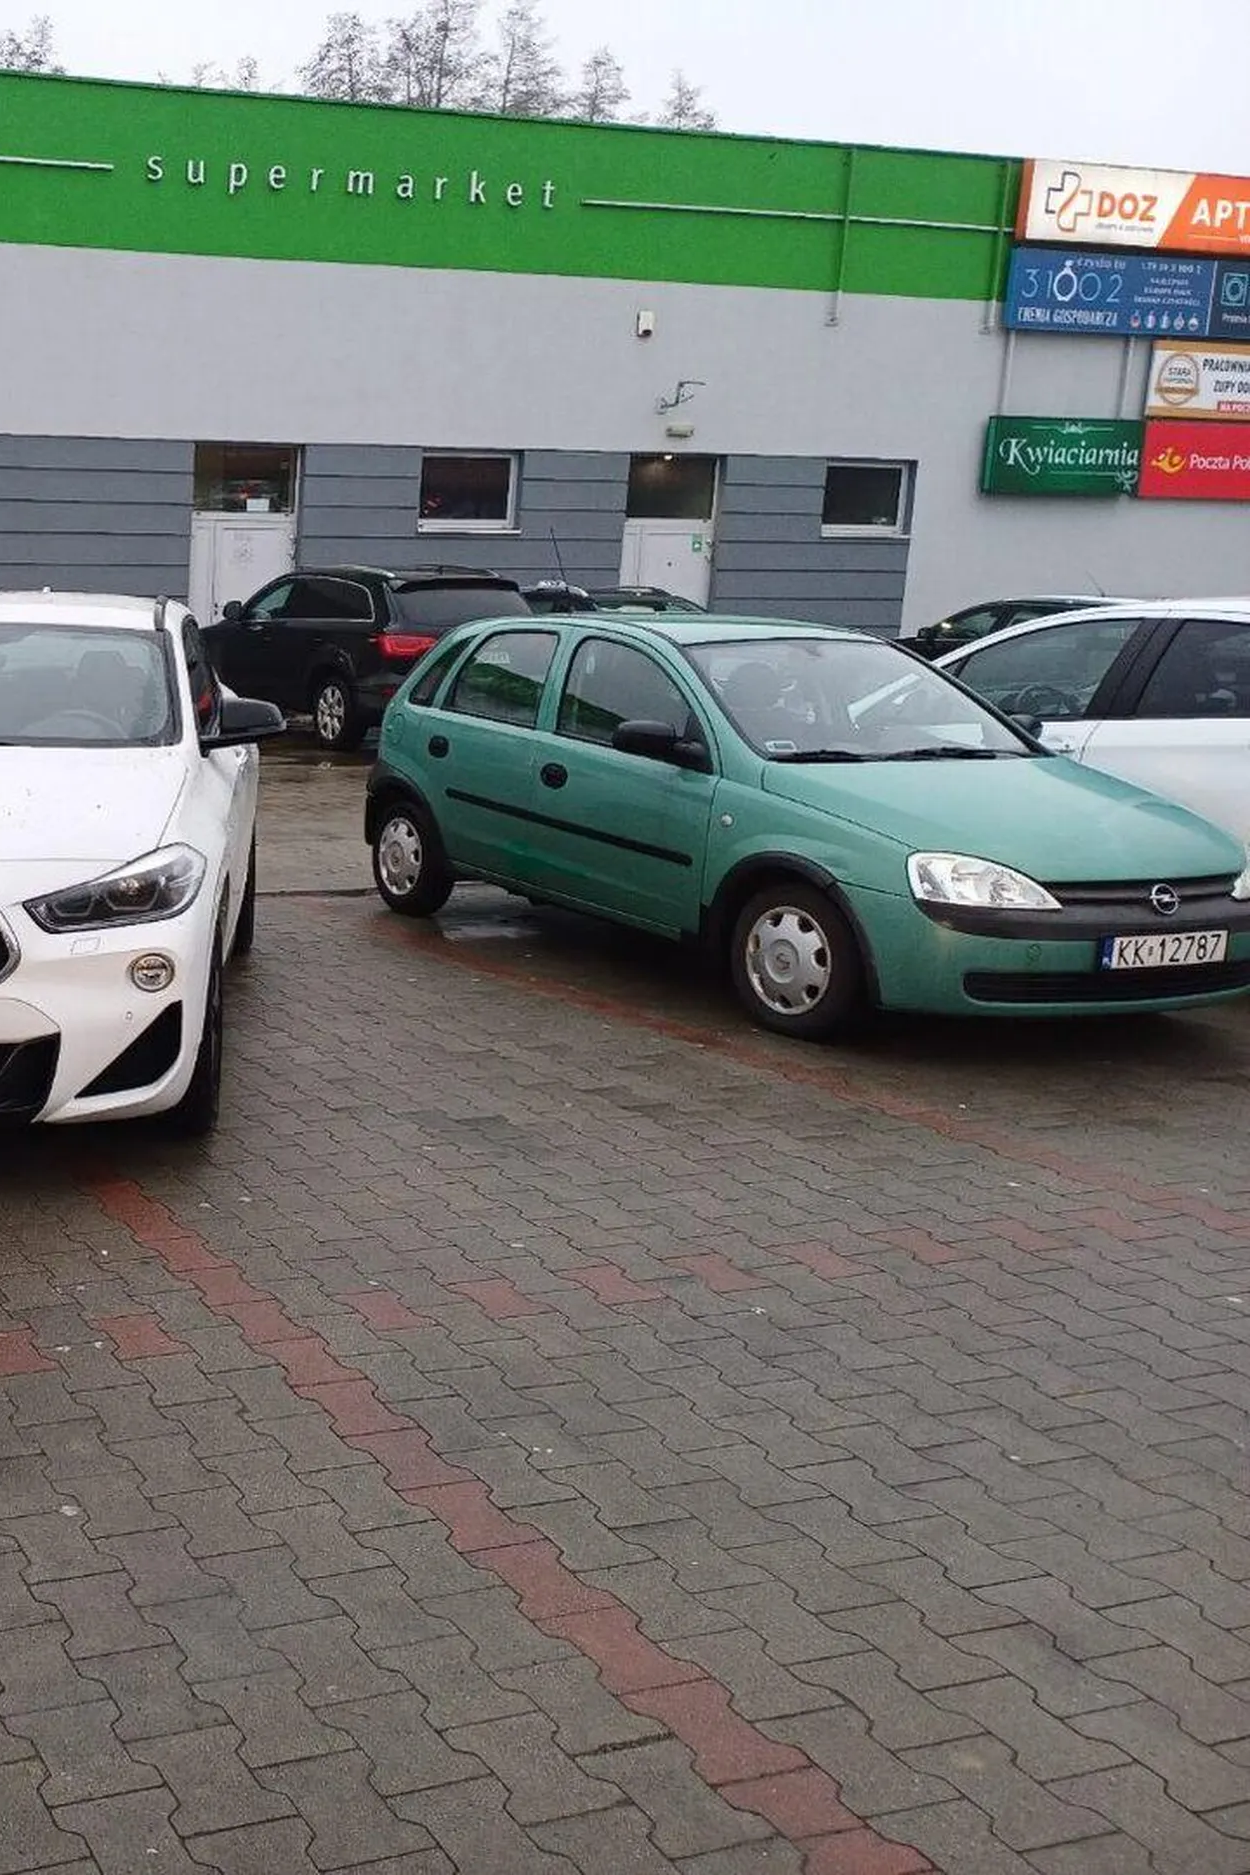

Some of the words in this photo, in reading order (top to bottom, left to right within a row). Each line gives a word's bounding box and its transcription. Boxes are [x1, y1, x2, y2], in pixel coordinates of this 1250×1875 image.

[145, 154, 556, 208] supermarket
[1097, 191, 1158, 222] DOZ
[999, 437, 1139, 476] Kwiaciarnia
[1190, 453, 1230, 470] Poczta
[1116, 938, 1148, 966] KK
[1159, 933, 1222, 964] 12787
